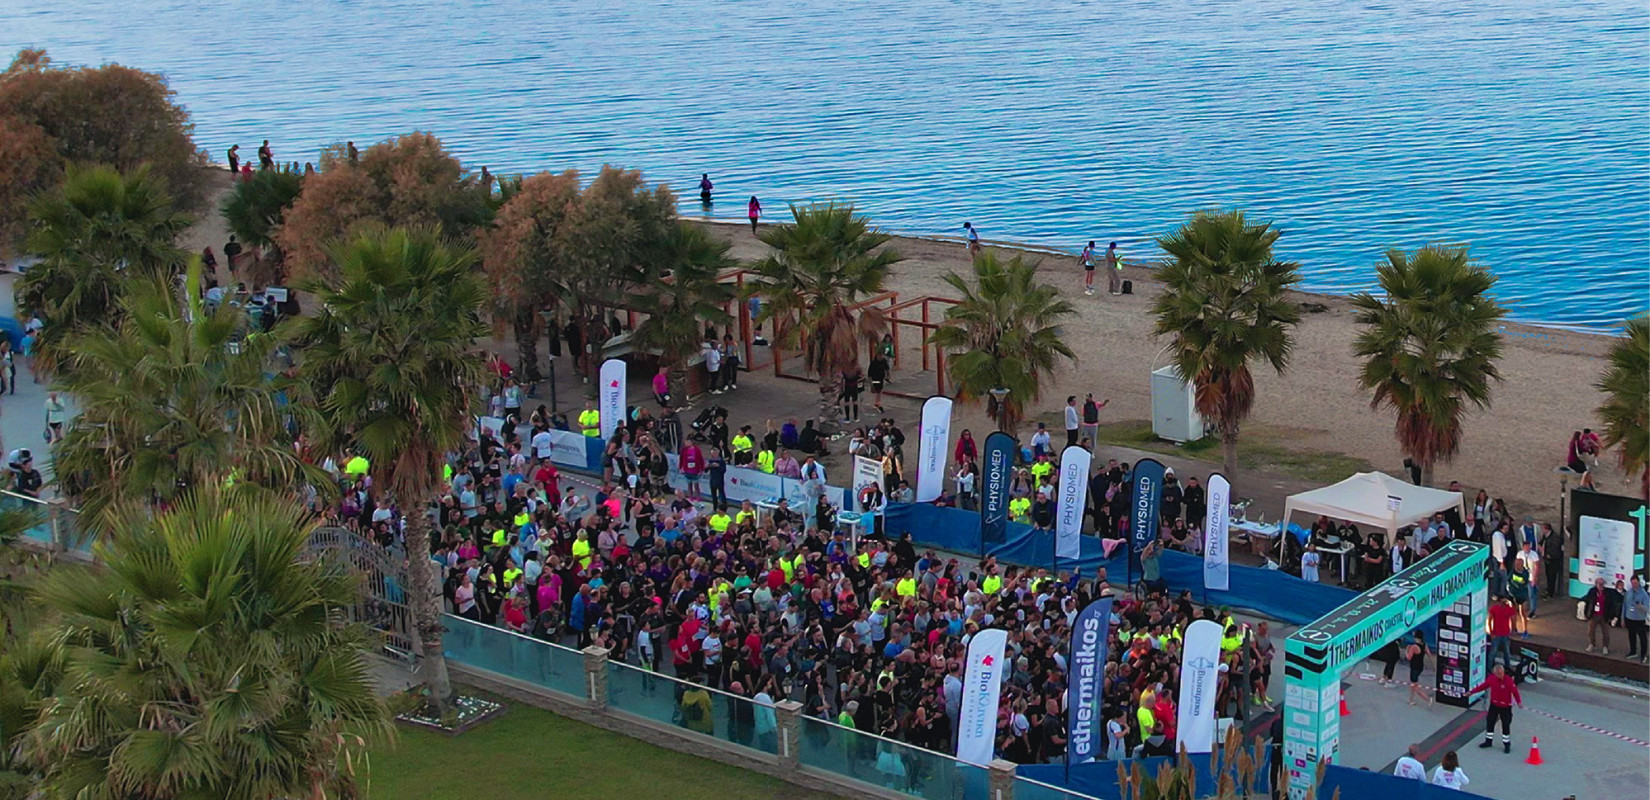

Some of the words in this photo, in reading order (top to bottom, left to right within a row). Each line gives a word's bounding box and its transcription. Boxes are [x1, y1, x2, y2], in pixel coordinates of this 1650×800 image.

[989, 449, 1002, 511] PHYSIOMED
[1063, 463, 1078, 525] PHYSIOMED
[1136, 476, 1150, 540] PHYSIOMED
[1209, 492, 1221, 556] PHYSIOMED
[1335, 619, 1385, 665] THERMAIKOS
